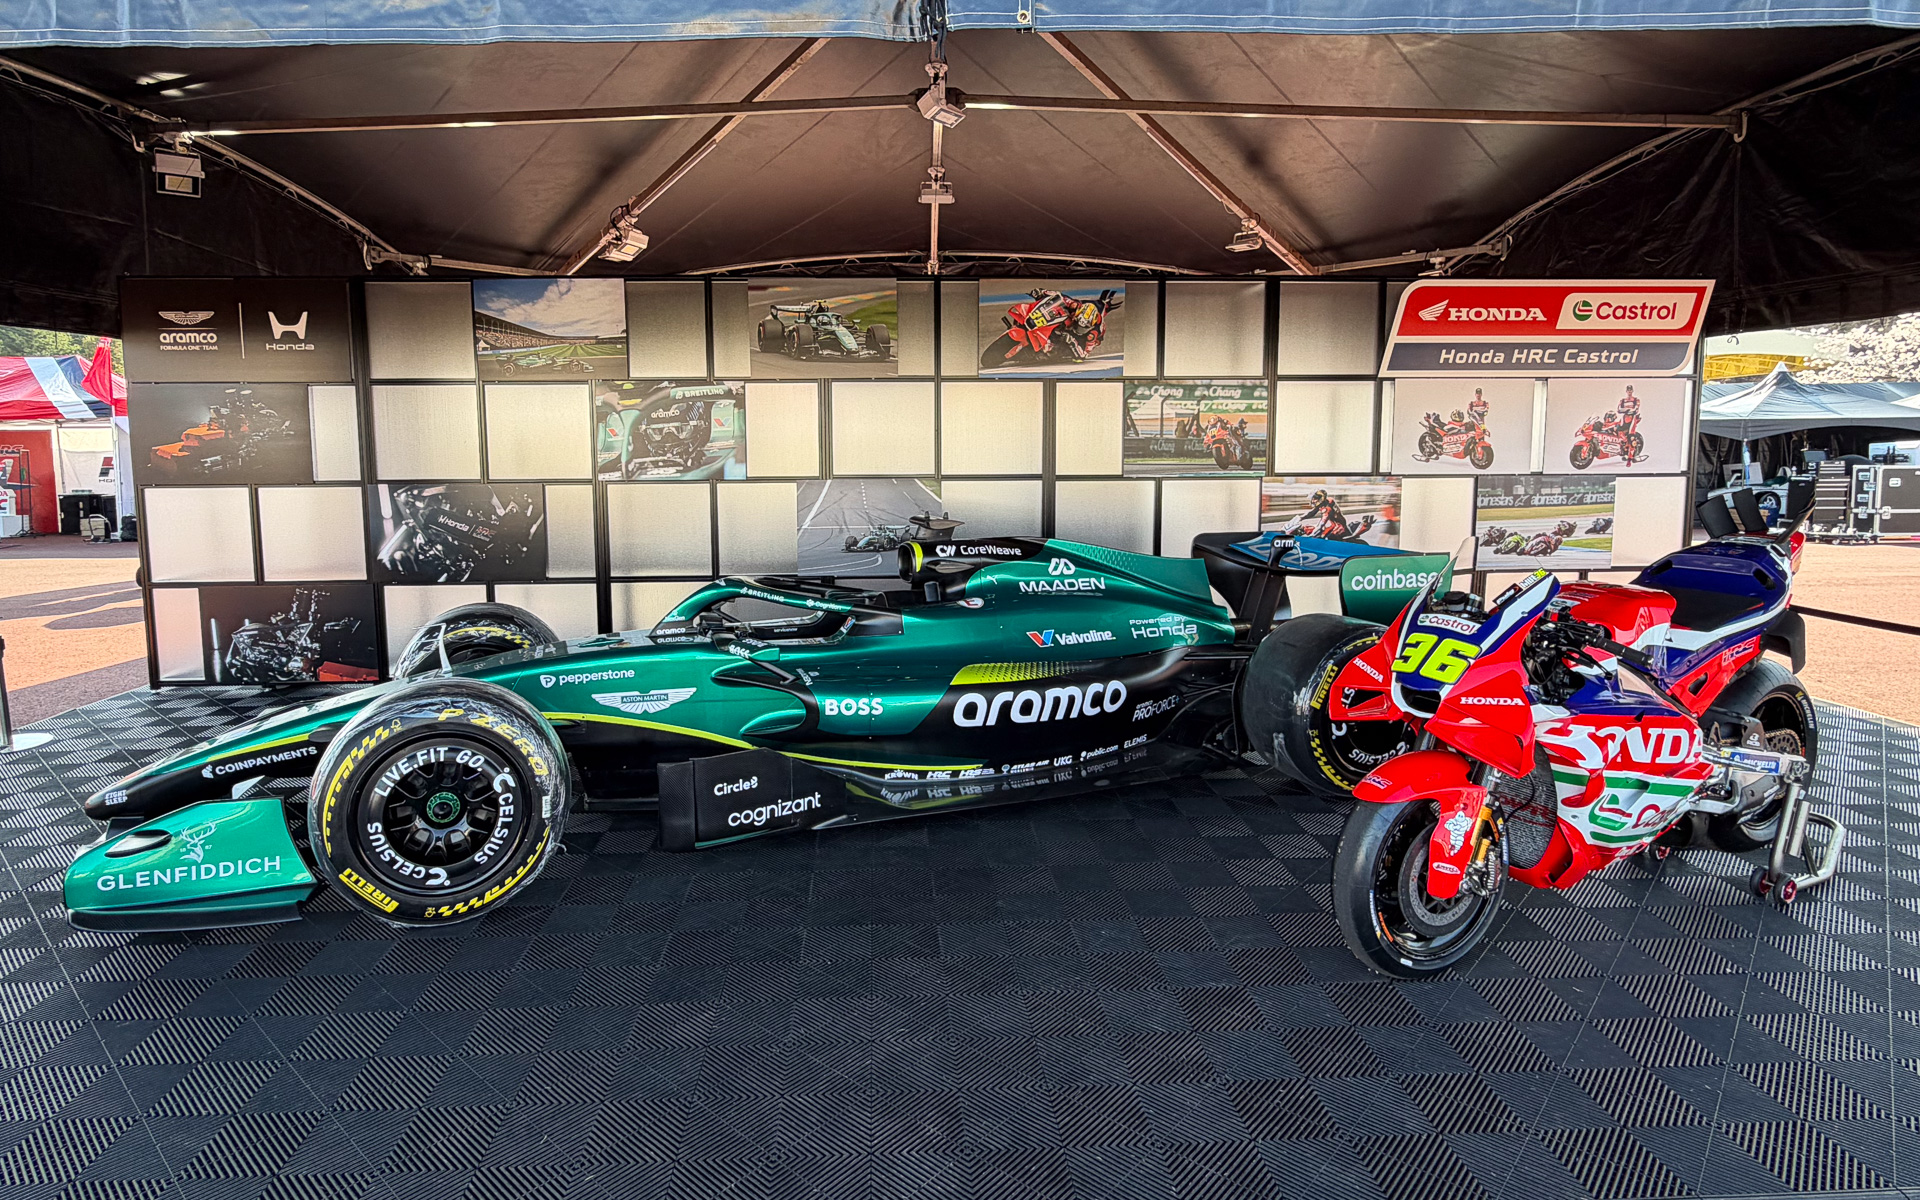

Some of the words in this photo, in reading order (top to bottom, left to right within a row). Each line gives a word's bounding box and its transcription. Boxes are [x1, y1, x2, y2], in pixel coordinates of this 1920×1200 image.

[1029, 308, 1048, 328] 36
[1447, 307, 1547, 321] HONDA
[1595, 301, 1677, 321] Castrol
[159, 332, 218, 343] aramco
[265, 343, 315, 351] Honda
[1439, 348, 1504, 364] Honda
[1511, 348, 1559, 364] HRC
[1563, 348, 1639, 364] Castrol
[684, 388, 724, 398] BREITLING
[1209, 385, 1242, 398] Chang
[651, 409, 680, 419] aramco
[444, 517, 470, 532] Honda
[960, 544, 1022, 556] CoreWeave
[1273, 538, 1294, 548] arm
[1019, 577, 1106, 593] MAADEN
[748, 589, 785, 602] BREITLING
[1129, 616, 1172, 626] Powered
[1174, 614, 1187, 624] by
[1428, 615, 1476, 634] Castrol
[656, 627, 686, 636] aramco
[1131, 622, 1198, 640] Honda
[1390, 632, 1481, 684] 36
[559, 669, 636, 686] pepperstone
[1353, 657, 1385, 684] HONDA
[1310, 663, 1339, 710] PIRELLI
[622, 695, 643, 703] ASTON
[643, 694, 668, 702] MARTIN
[953, 680, 1127, 728] aramco
[1459, 696, 1525, 706] HONDA
[824, 697, 884, 716] BOSS
[438, 708, 464, 721] P
[470, 713, 549, 776] ZERO
[1124, 734, 1147, 749] ELEMIS
[1086, 744, 1119, 759] public.com
[215, 746, 318, 776] COINPAYMENTS
[455, 750, 486, 772] GO.
[1036, 759, 1050, 767] AIR
[1053, 755, 1073, 767] UKG
[884, 770, 919, 780] KROWN
[926, 770, 952, 779] HRC
[105, 790, 127, 799] EIGHT
[105, 796, 128, 806] SLEEP
[727, 792, 822, 827] cognizant
[474, 794, 514, 865] CELSIUS
[367, 821, 426, 879] CELSIUS
[96, 855, 282, 892] GLENFIDDICH
[338, 868, 400, 914] PIRELLI
